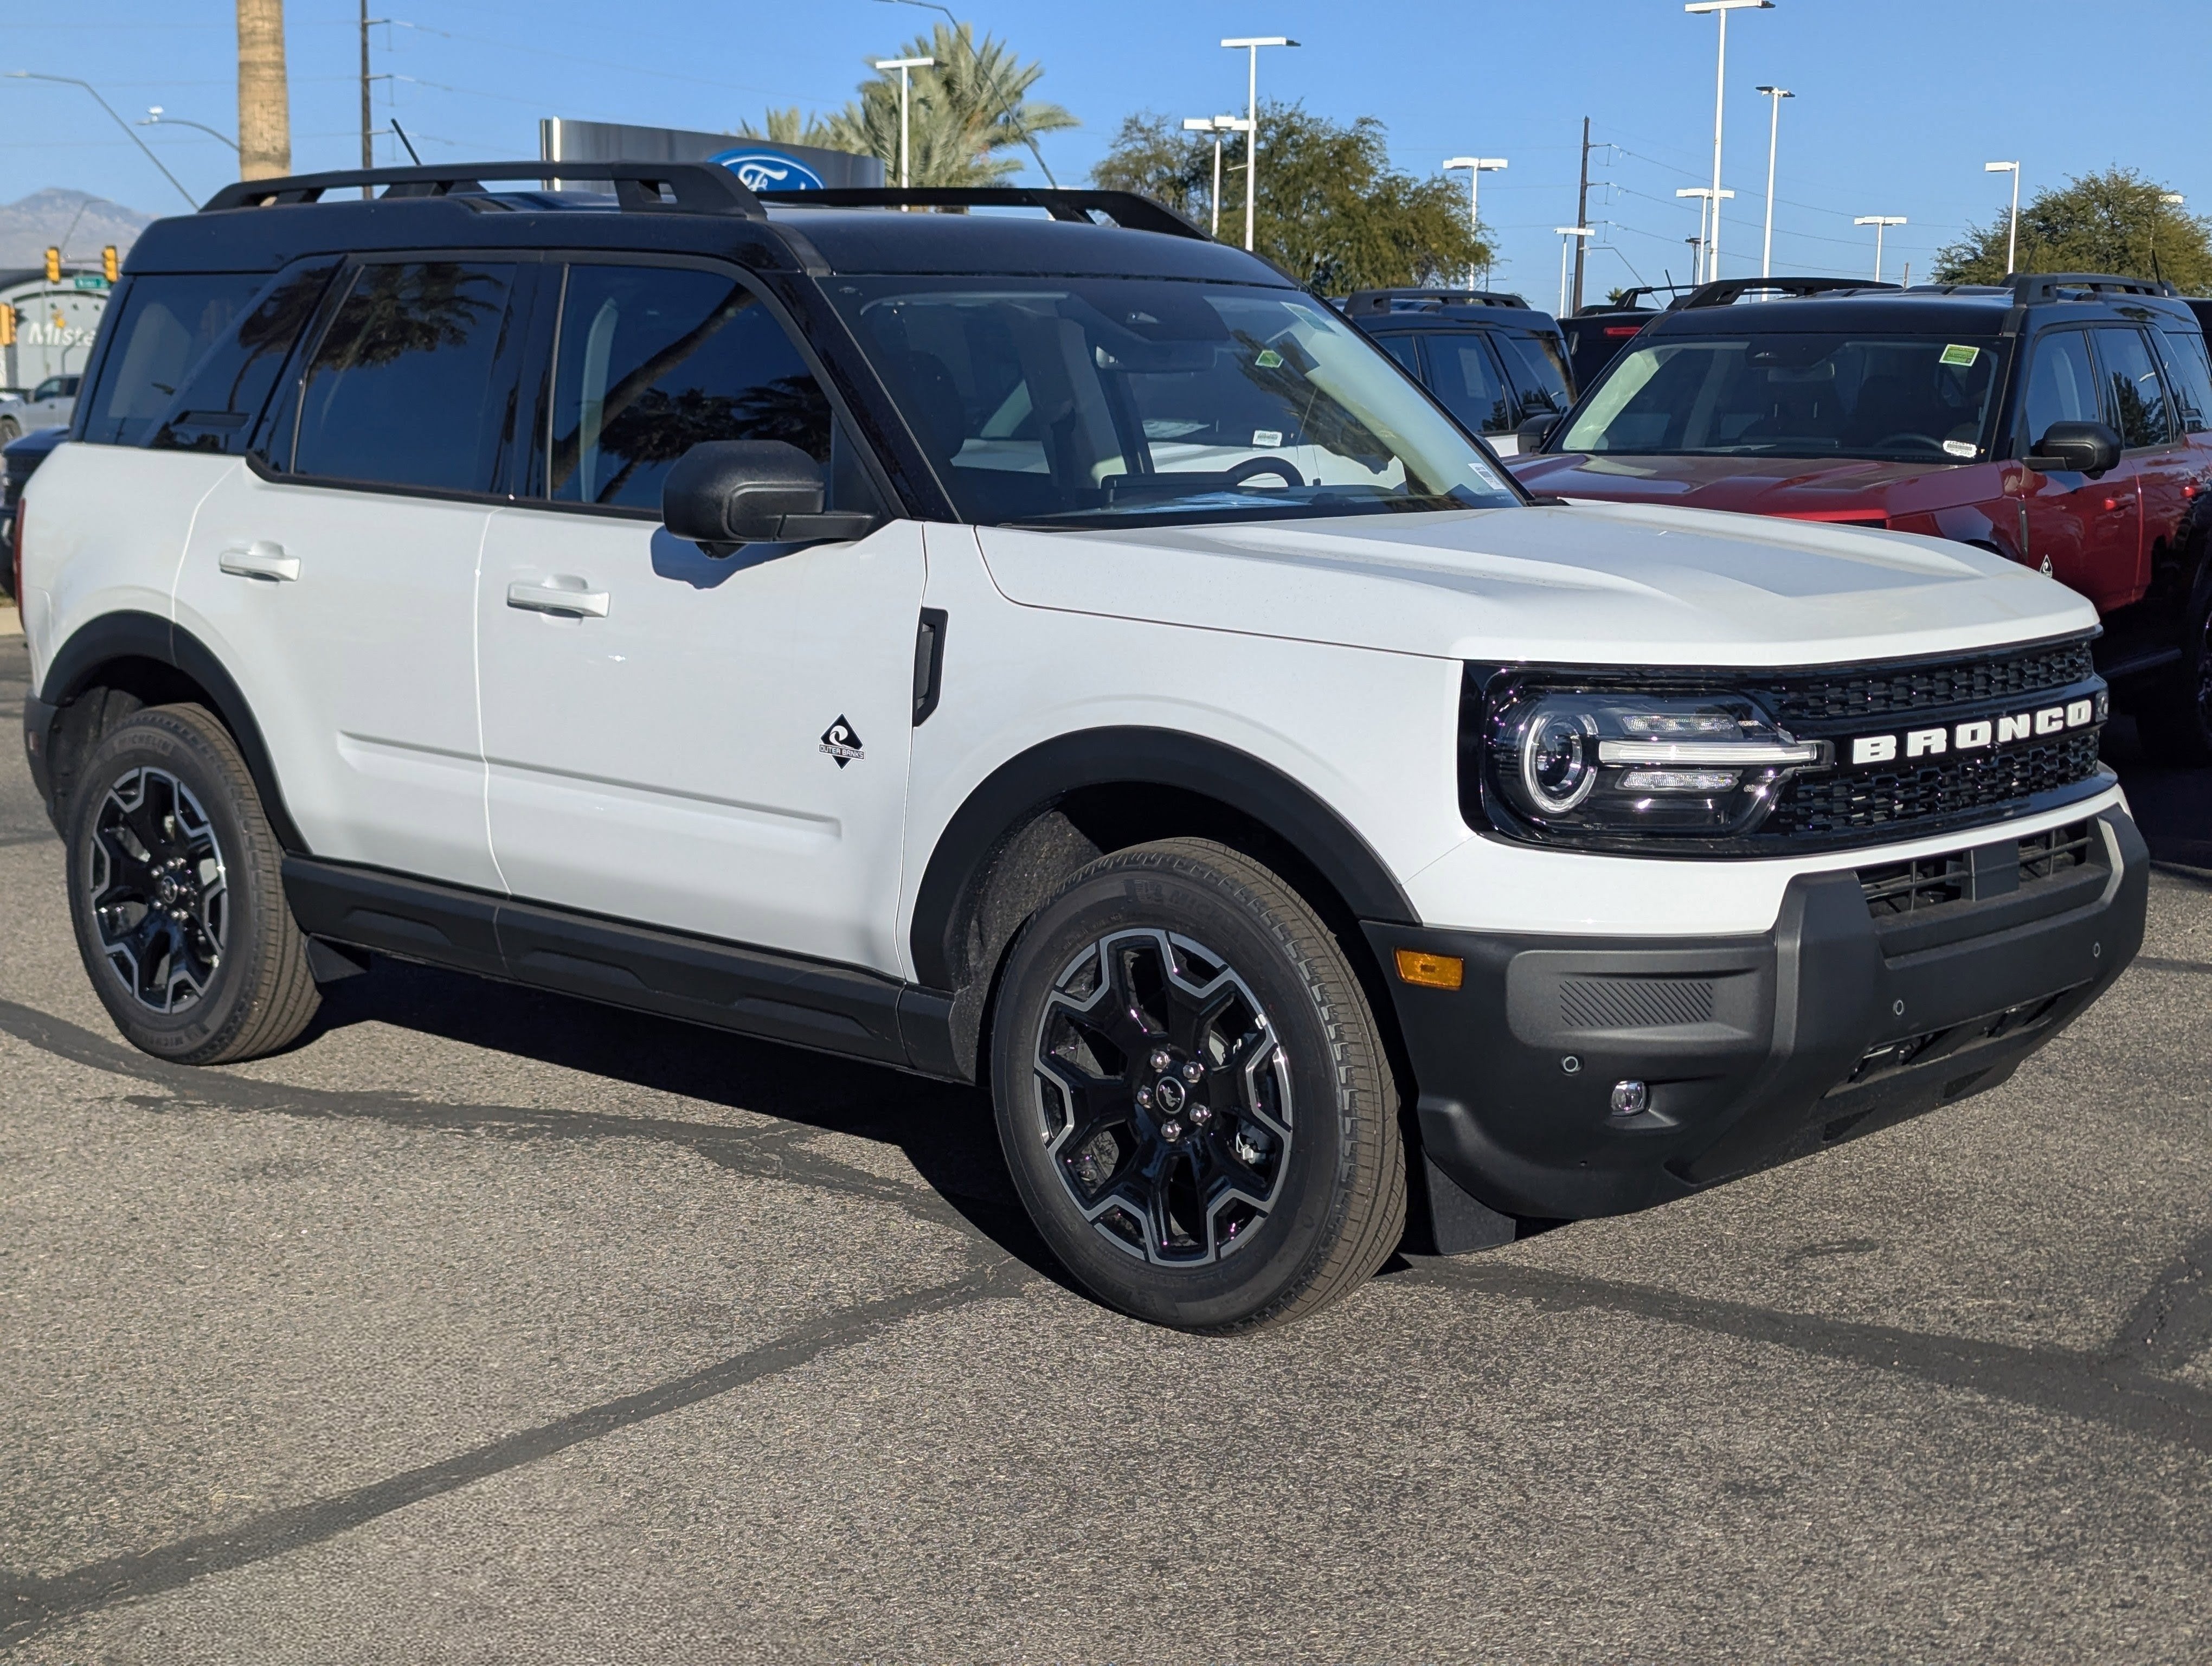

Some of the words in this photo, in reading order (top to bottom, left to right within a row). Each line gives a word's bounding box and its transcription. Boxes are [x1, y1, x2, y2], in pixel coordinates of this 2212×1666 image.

[820, 745, 841, 754] OUTER
[842, 749, 864, 759] BANKS
[1852, 699, 2092, 765] BRONCO
